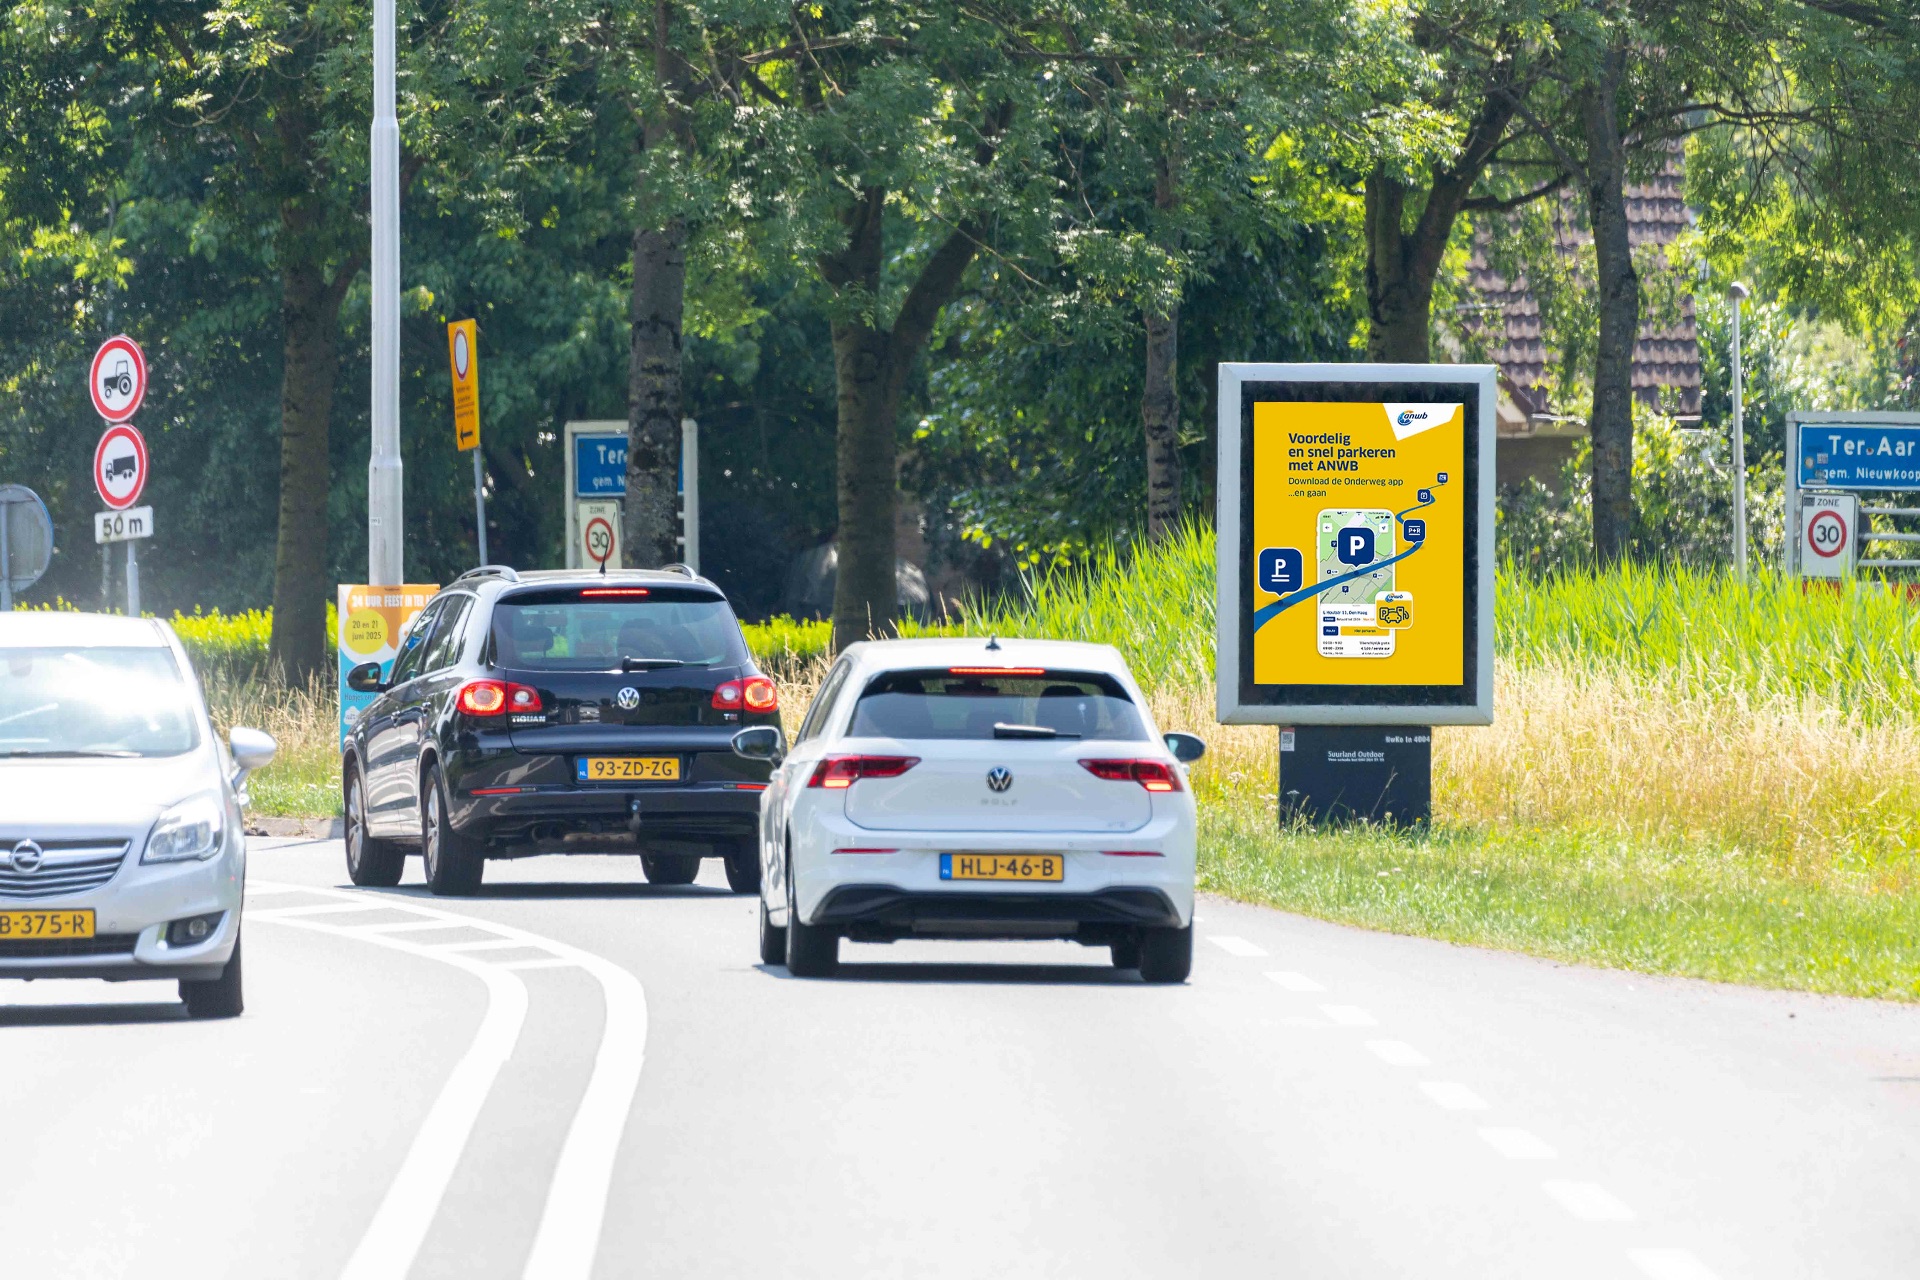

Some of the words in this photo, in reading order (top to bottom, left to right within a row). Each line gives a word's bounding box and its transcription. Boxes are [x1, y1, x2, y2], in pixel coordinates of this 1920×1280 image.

[1288, 433, 1351, 445] Voordelig
[1828, 435, 1866, 456] Ter
[1876, 436, 1916, 457] Aar
[596, 445, 623, 465] Ter
[1288, 448, 1304, 457] en
[1307, 447, 1333, 457] snel
[1337, 447, 1396, 459] parkeren
[1288, 461, 1314, 471] met
[1316, 460, 1359, 471] ANWB
[1288, 477, 1330, 485] Download
[1331, 477, 1342, 485] de
[1344, 477, 1386, 487] Onderweg
[1288, 489, 1305, 497] ...en
[1306, 490, 1327, 498] gaan
[1816, 498, 1840, 507] ZONE
[103, 515, 124, 536] 50
[129, 518, 143, 533] m
[590, 532, 610, 548] 30
[1815, 525, 1840, 544] 30
[1349, 536, 1365, 557] P
[366, 594, 382, 608] UUR
[352, 620, 361, 629] 20
[371, 620, 379, 629] 21
[352, 631, 364, 642] juni
[366, 631, 382, 640] 2025
[595, 761, 673, 777] 93-ZD-ZG
[960, 858, 1055, 876] HLJ-46-B
[0, 914, 85, 935] B-375-R
